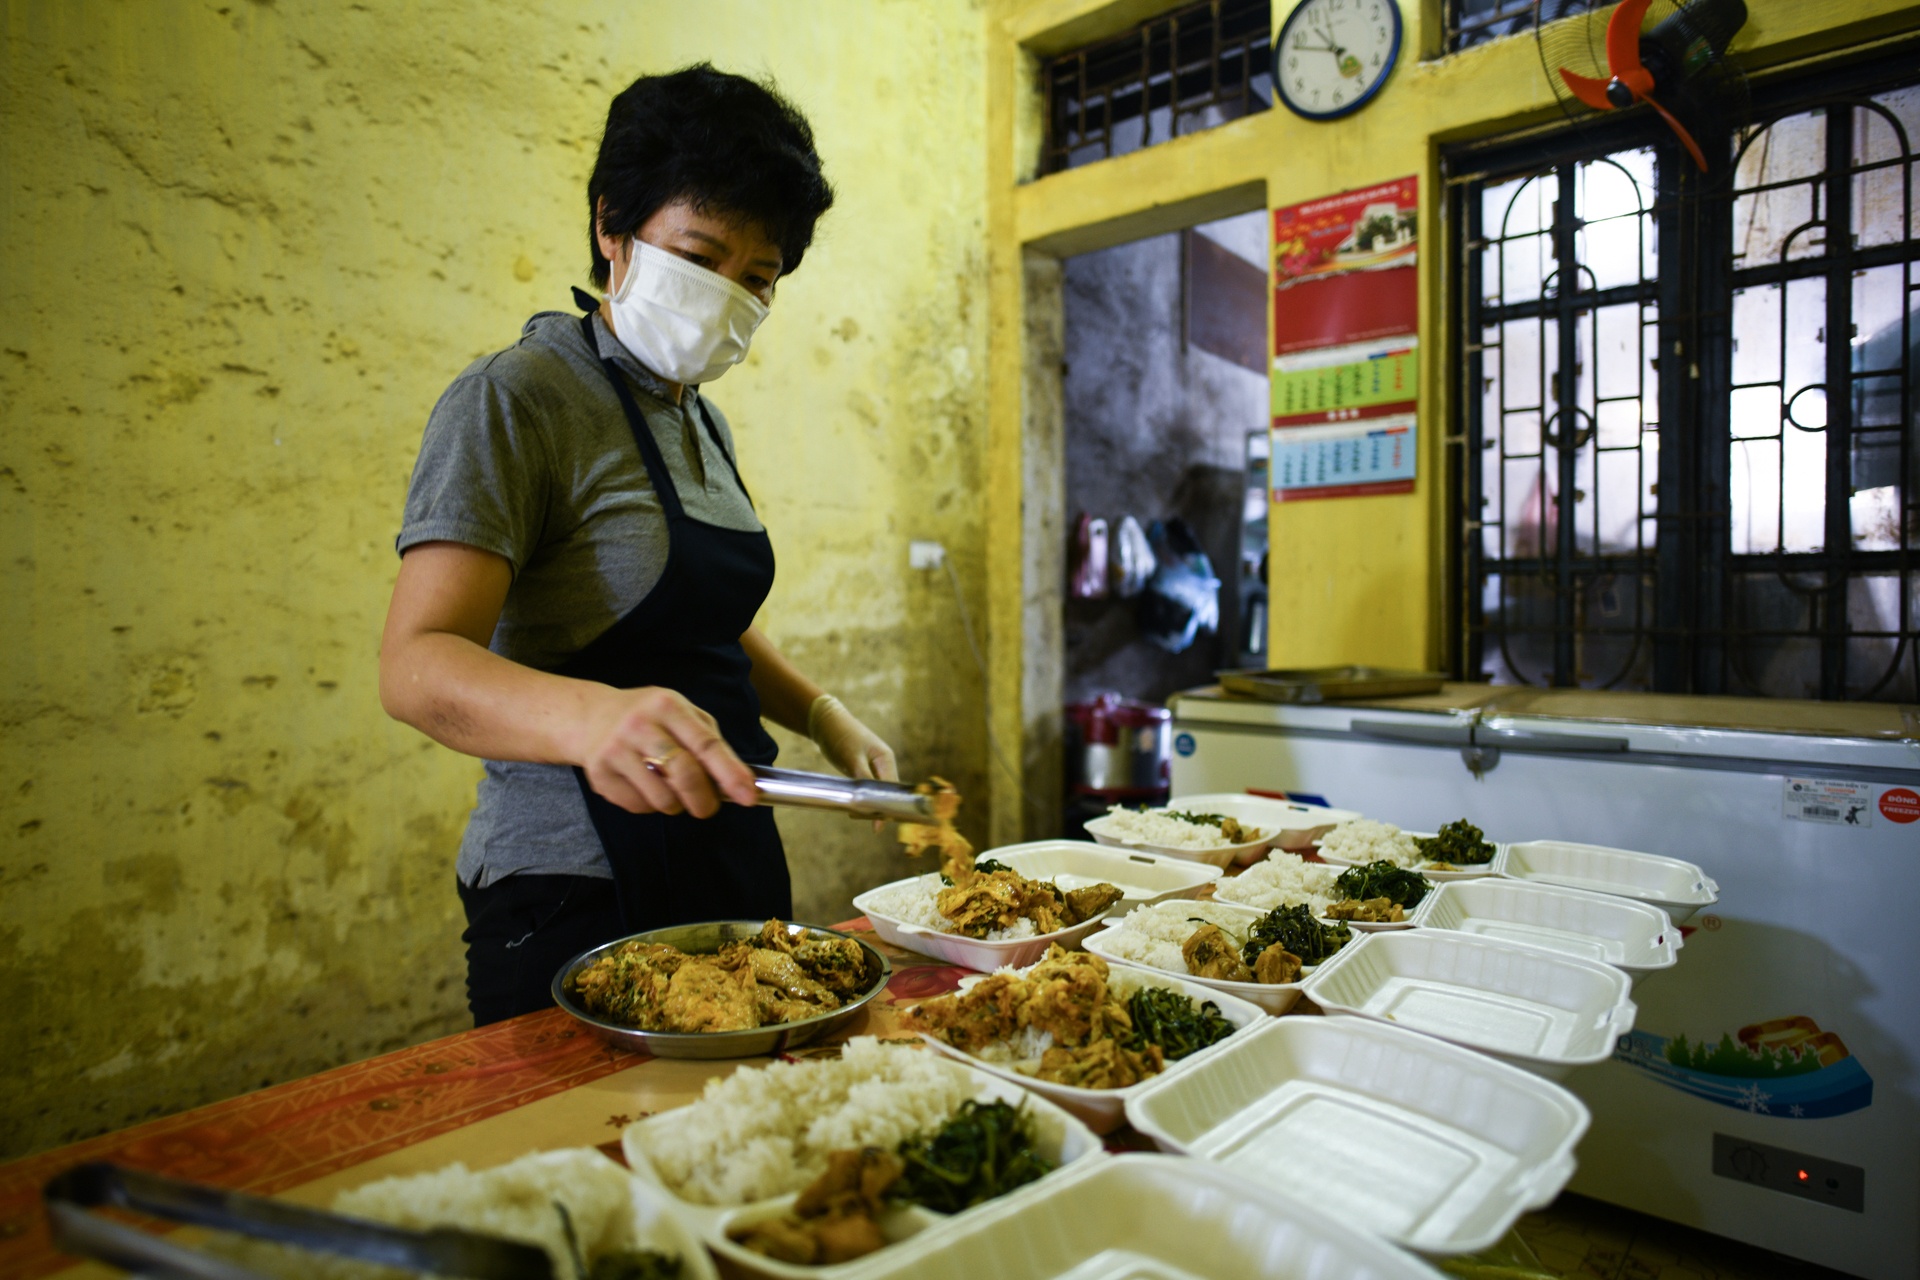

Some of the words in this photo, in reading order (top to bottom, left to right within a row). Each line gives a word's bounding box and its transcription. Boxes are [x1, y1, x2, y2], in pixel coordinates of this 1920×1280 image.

[1308, 9, 1320, 25] 11
[1371, 4, 1380, 21] 2
[1293, 30, 1308, 46] 10
[1378, 26, 1387, 43] 3
[1289, 56, 1298, 72] 9
[1371, 51, 1380, 67] 4
[1333, 88, 1343, 104] 6
[1883, 806, 1920, 815] FREEZER
[1617, 1035, 1652, 1059] 0%
